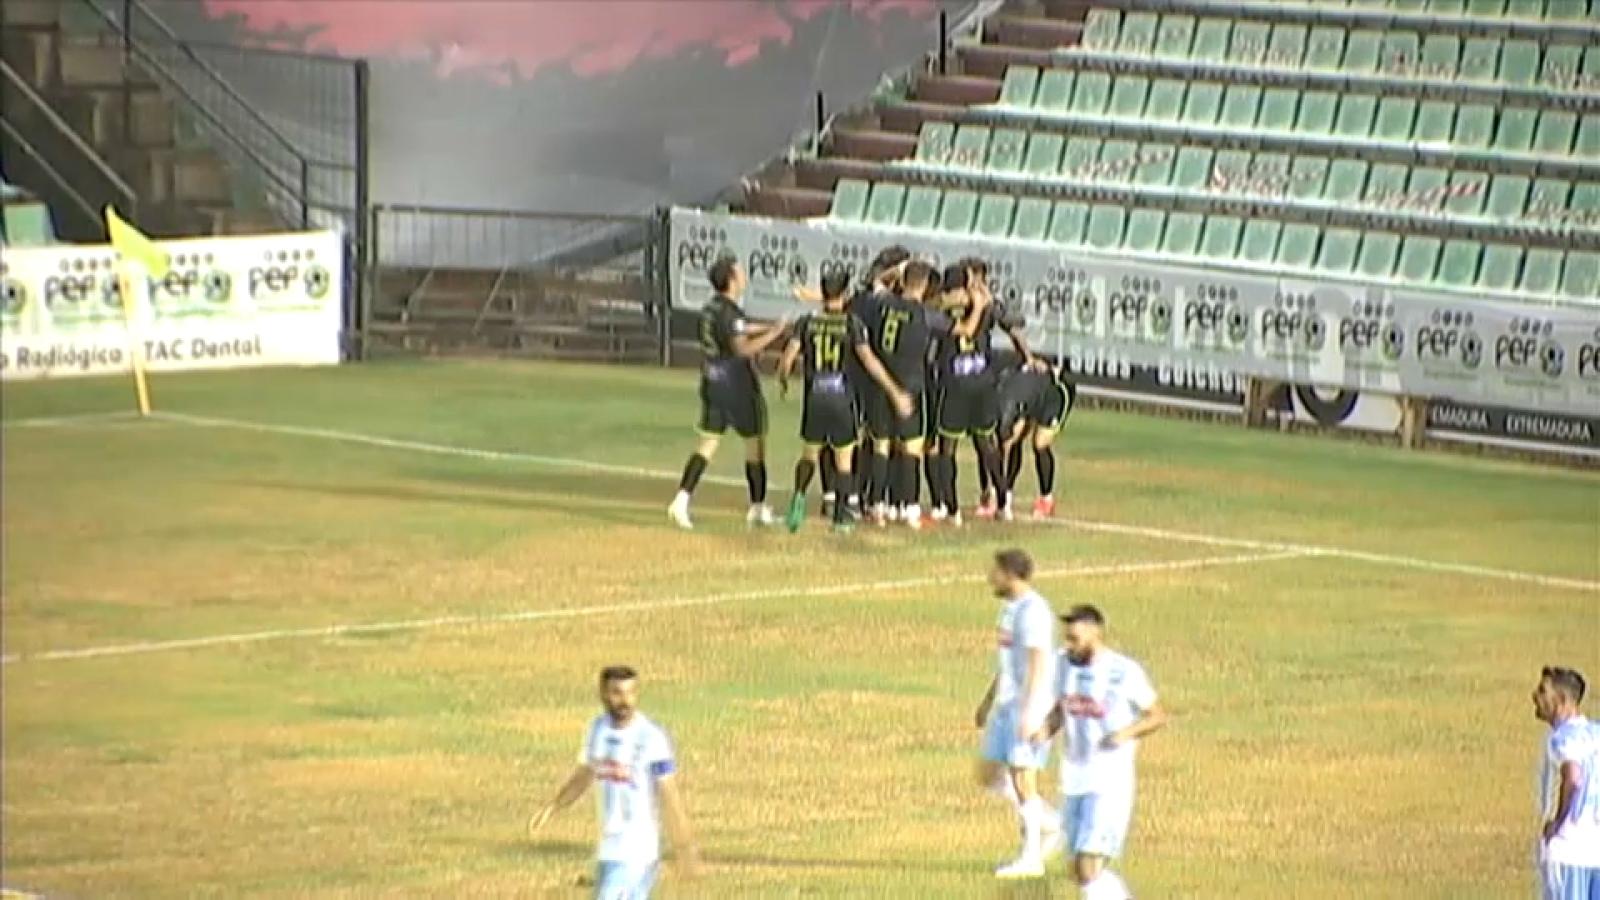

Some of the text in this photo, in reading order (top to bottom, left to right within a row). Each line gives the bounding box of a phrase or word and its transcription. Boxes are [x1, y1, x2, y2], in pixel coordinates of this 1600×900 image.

[144, 339, 184, 361] TAC
[191, 334, 262, 359] Dental
[813, 333, 841, 371] 14
